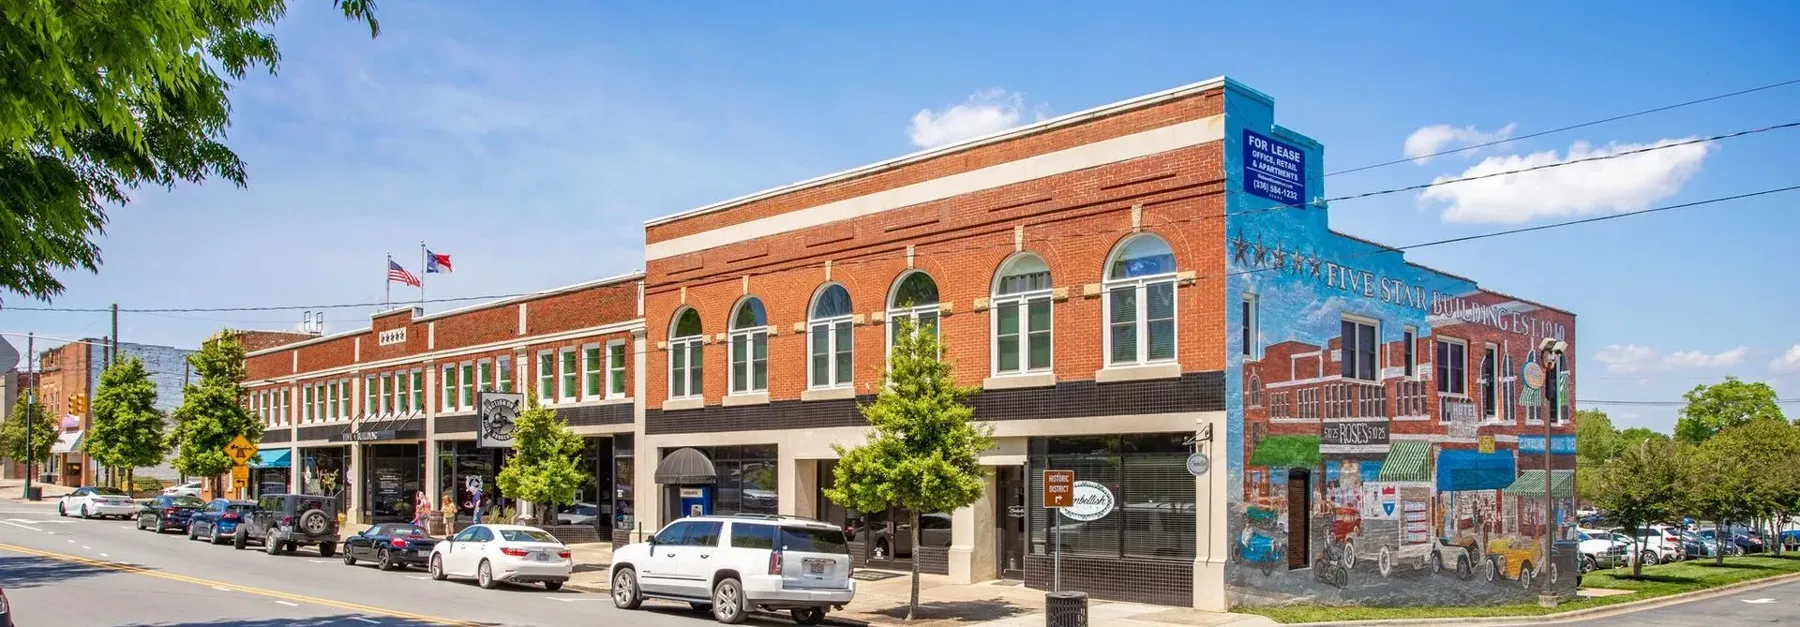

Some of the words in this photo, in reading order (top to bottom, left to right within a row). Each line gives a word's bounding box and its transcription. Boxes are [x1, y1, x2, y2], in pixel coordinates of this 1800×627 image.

[1249, 135, 1268, 152] FOR
[1271, 143, 1301, 163] LEASE
[1252, 150, 1276, 166] OFFICE,
[1276, 158, 1298, 172] RETAIL
[1252, 160, 1257, 168] &
[1258, 162, 1298, 181] APARTMENTS
[1253, 179, 1269, 193] (336)
[1270, 184, 1298, 200] 584-1232
[1326, 261, 1375, 298] FIVE
[1380, 275, 1428, 311] STAR
[1433, 290, 1508, 331] BUILDING
[1513, 311, 1539, 337] EST.
[1453, 403, 1477, 416] HOTEL
[1048, 474, 1070, 483] HISTORIC
[1048, 485, 1069, 493] DISTRICT
